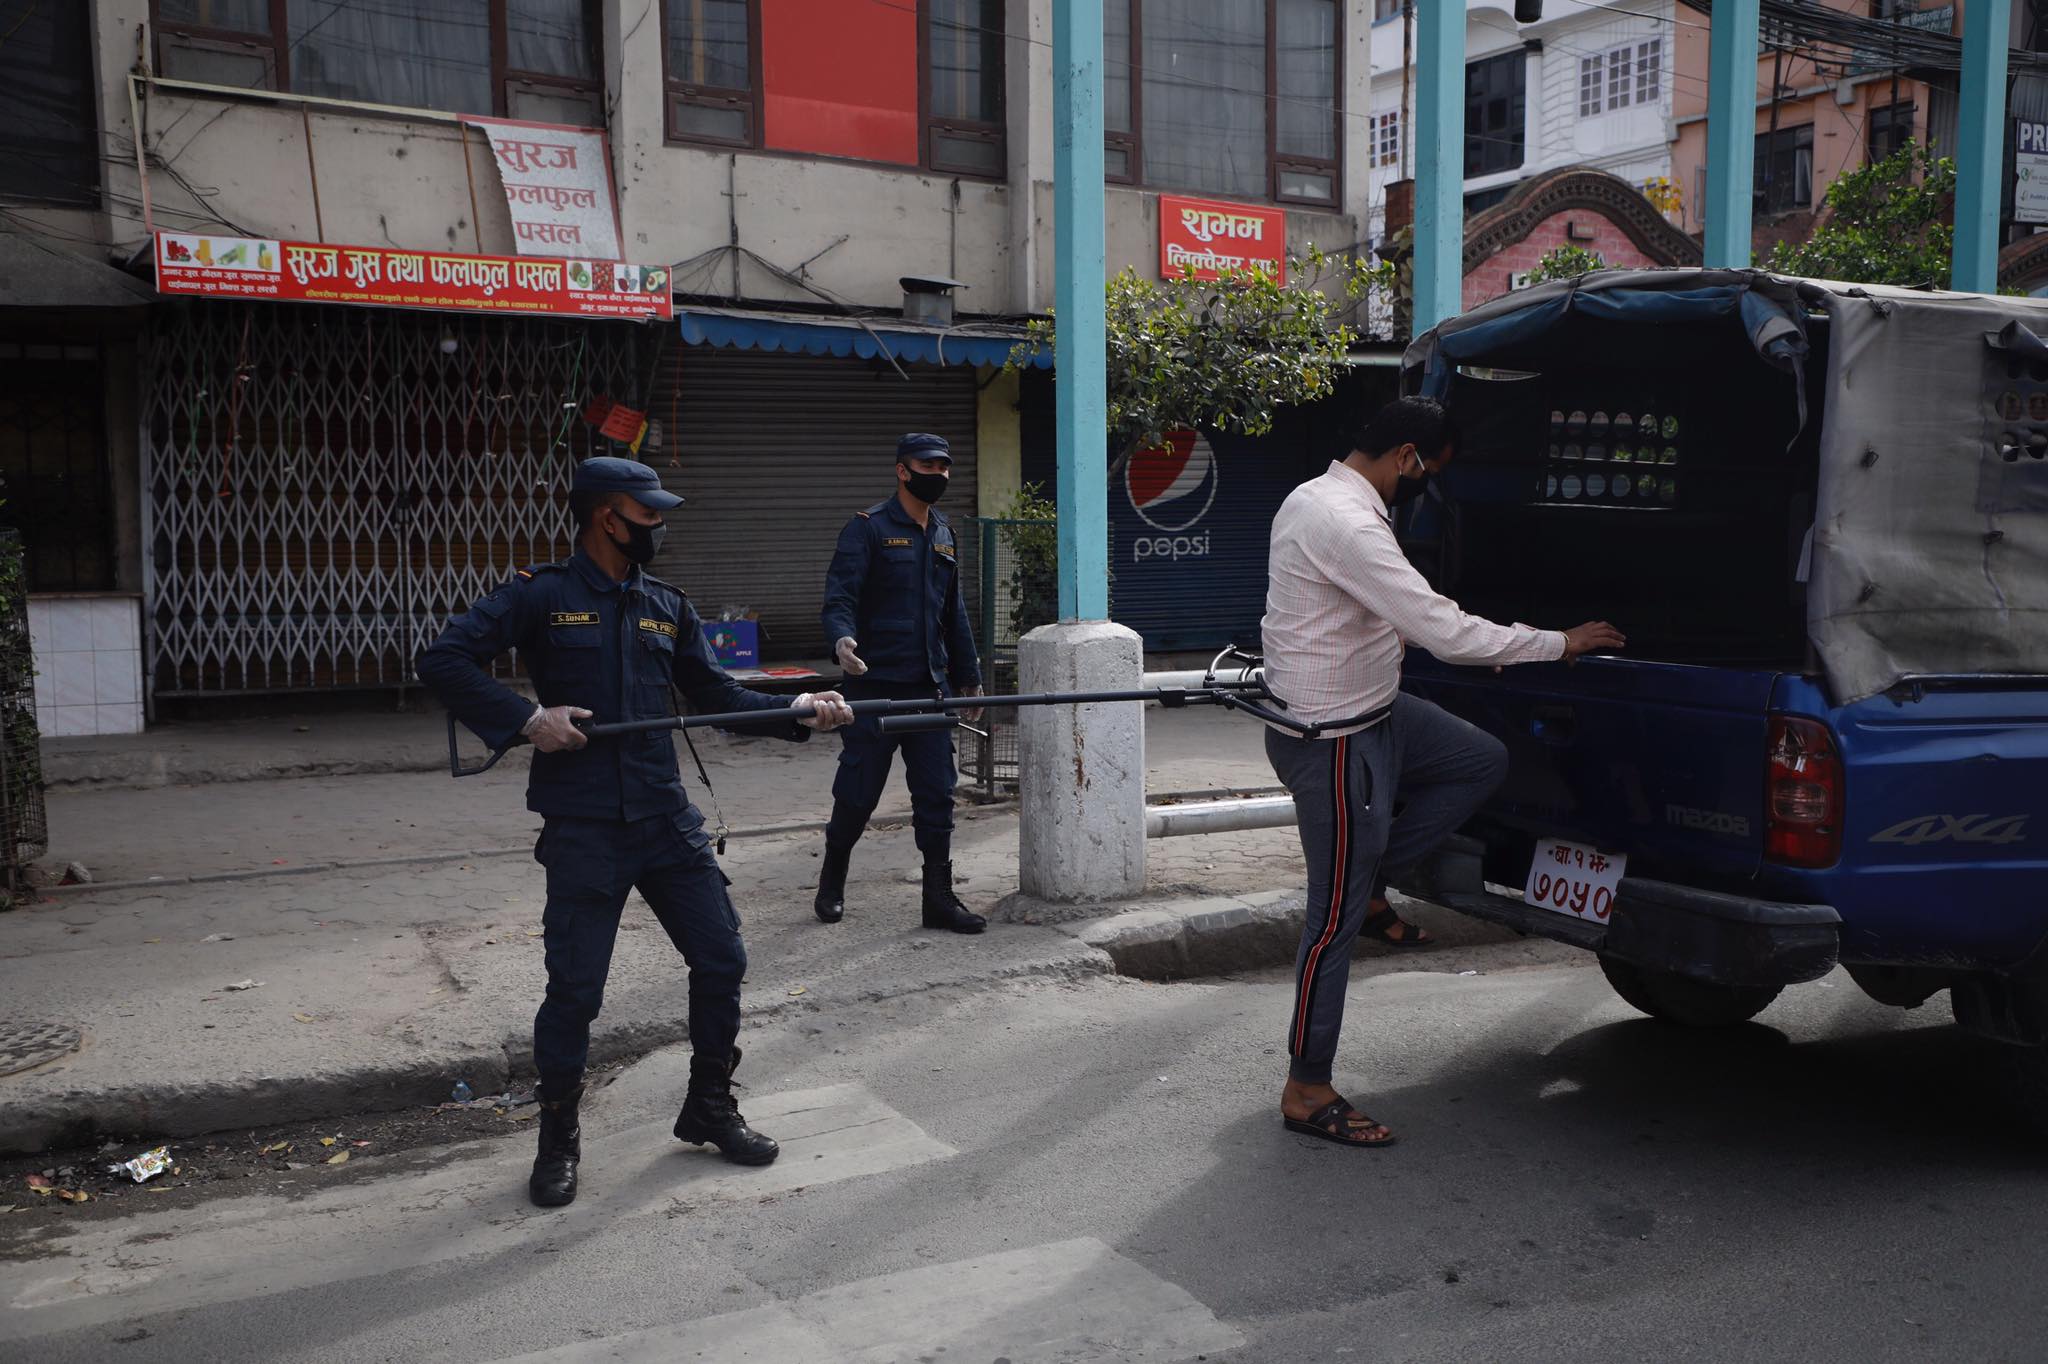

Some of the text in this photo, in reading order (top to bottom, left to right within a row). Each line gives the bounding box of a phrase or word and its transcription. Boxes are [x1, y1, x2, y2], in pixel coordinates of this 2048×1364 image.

[2020, 122, 2048, 152] PR
[494, 139, 577, 173] सुरज
[515, 221, 582, 245] पसल
[1180, 208, 1265, 242] शुभम
[286, 246, 562, 296] सुरज जुस तथा फलफुल पसल
[1134, 529, 1210, 562] pepsi
[1533, 872, 1614, 919] ७०५०
